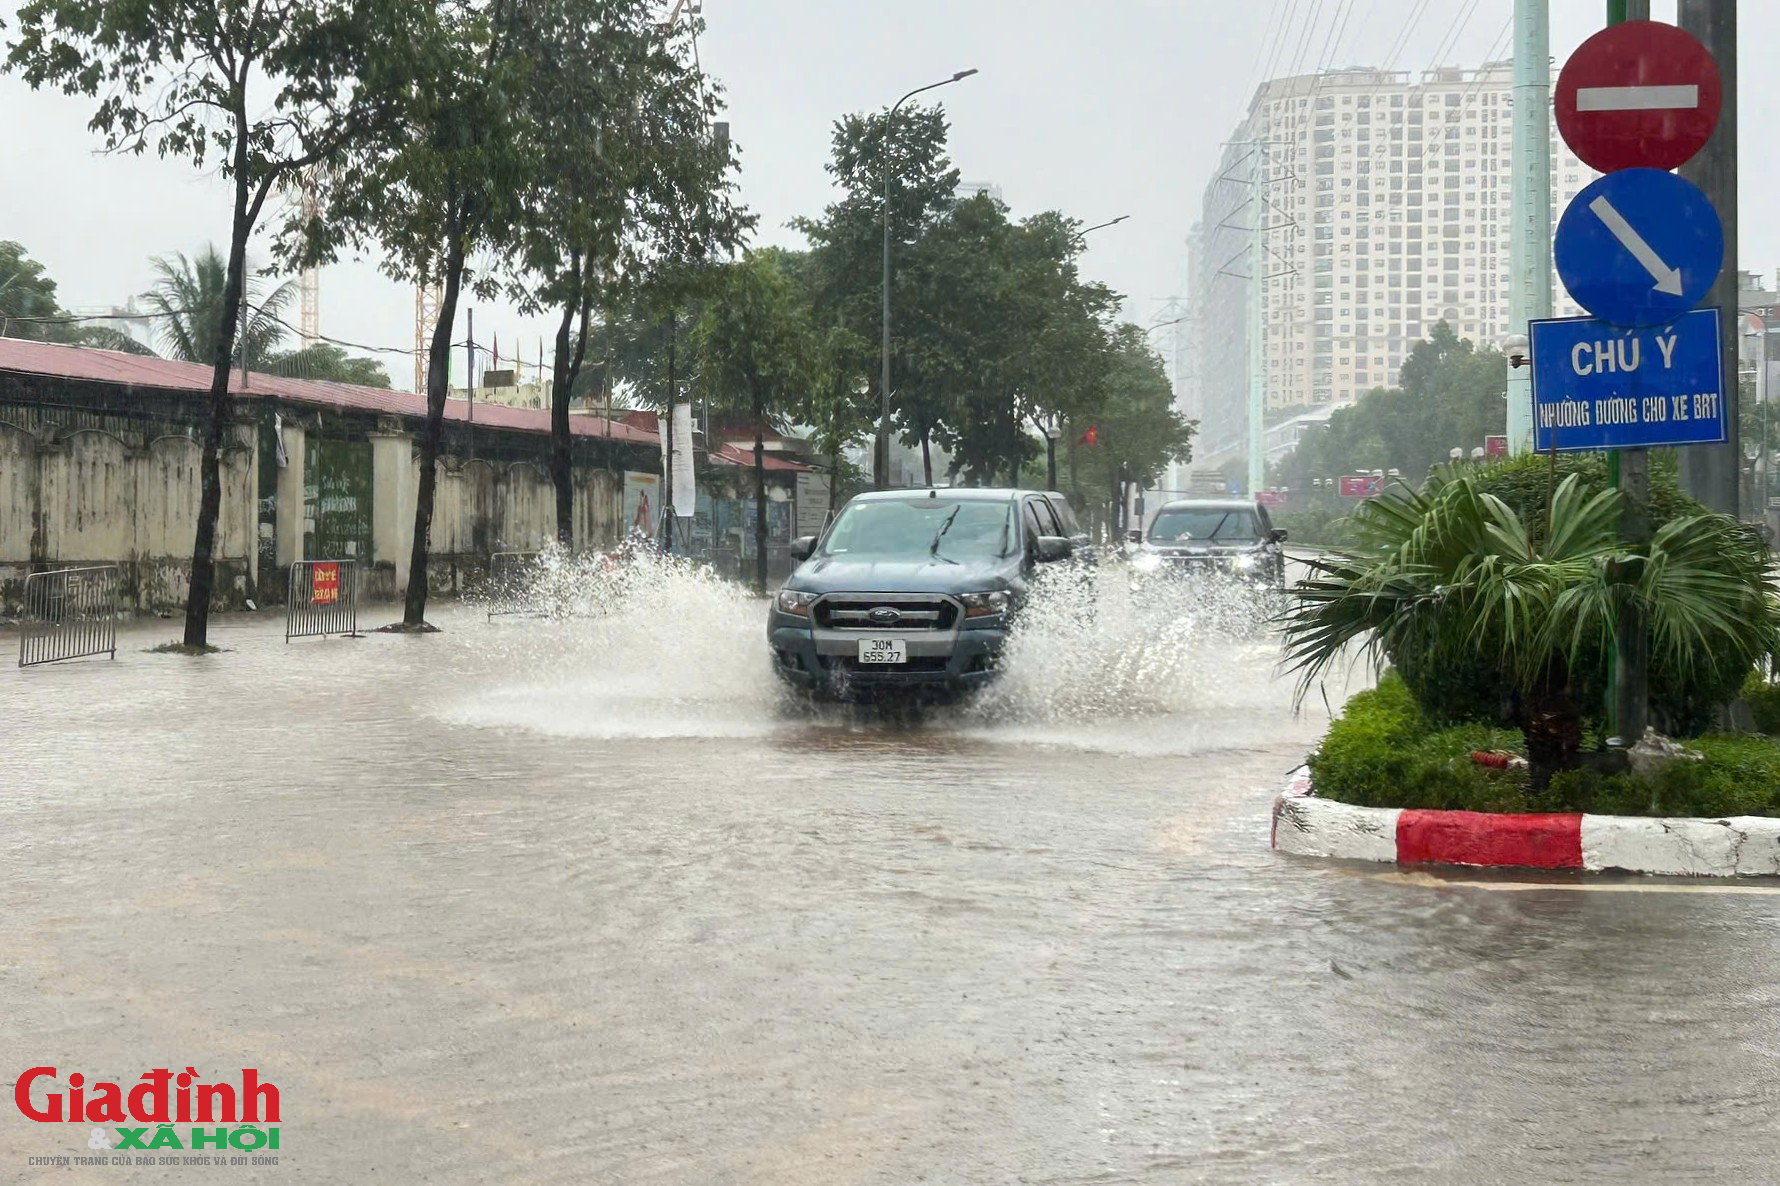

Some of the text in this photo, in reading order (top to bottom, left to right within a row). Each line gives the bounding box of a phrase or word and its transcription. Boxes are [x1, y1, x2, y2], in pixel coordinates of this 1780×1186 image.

[1571, 325, 1678, 376] CHÚ Ý
[1642, 396, 1666, 423] CHO
[1671, 394, 1689, 421] XE
[1693, 393, 1718, 420] BRT
